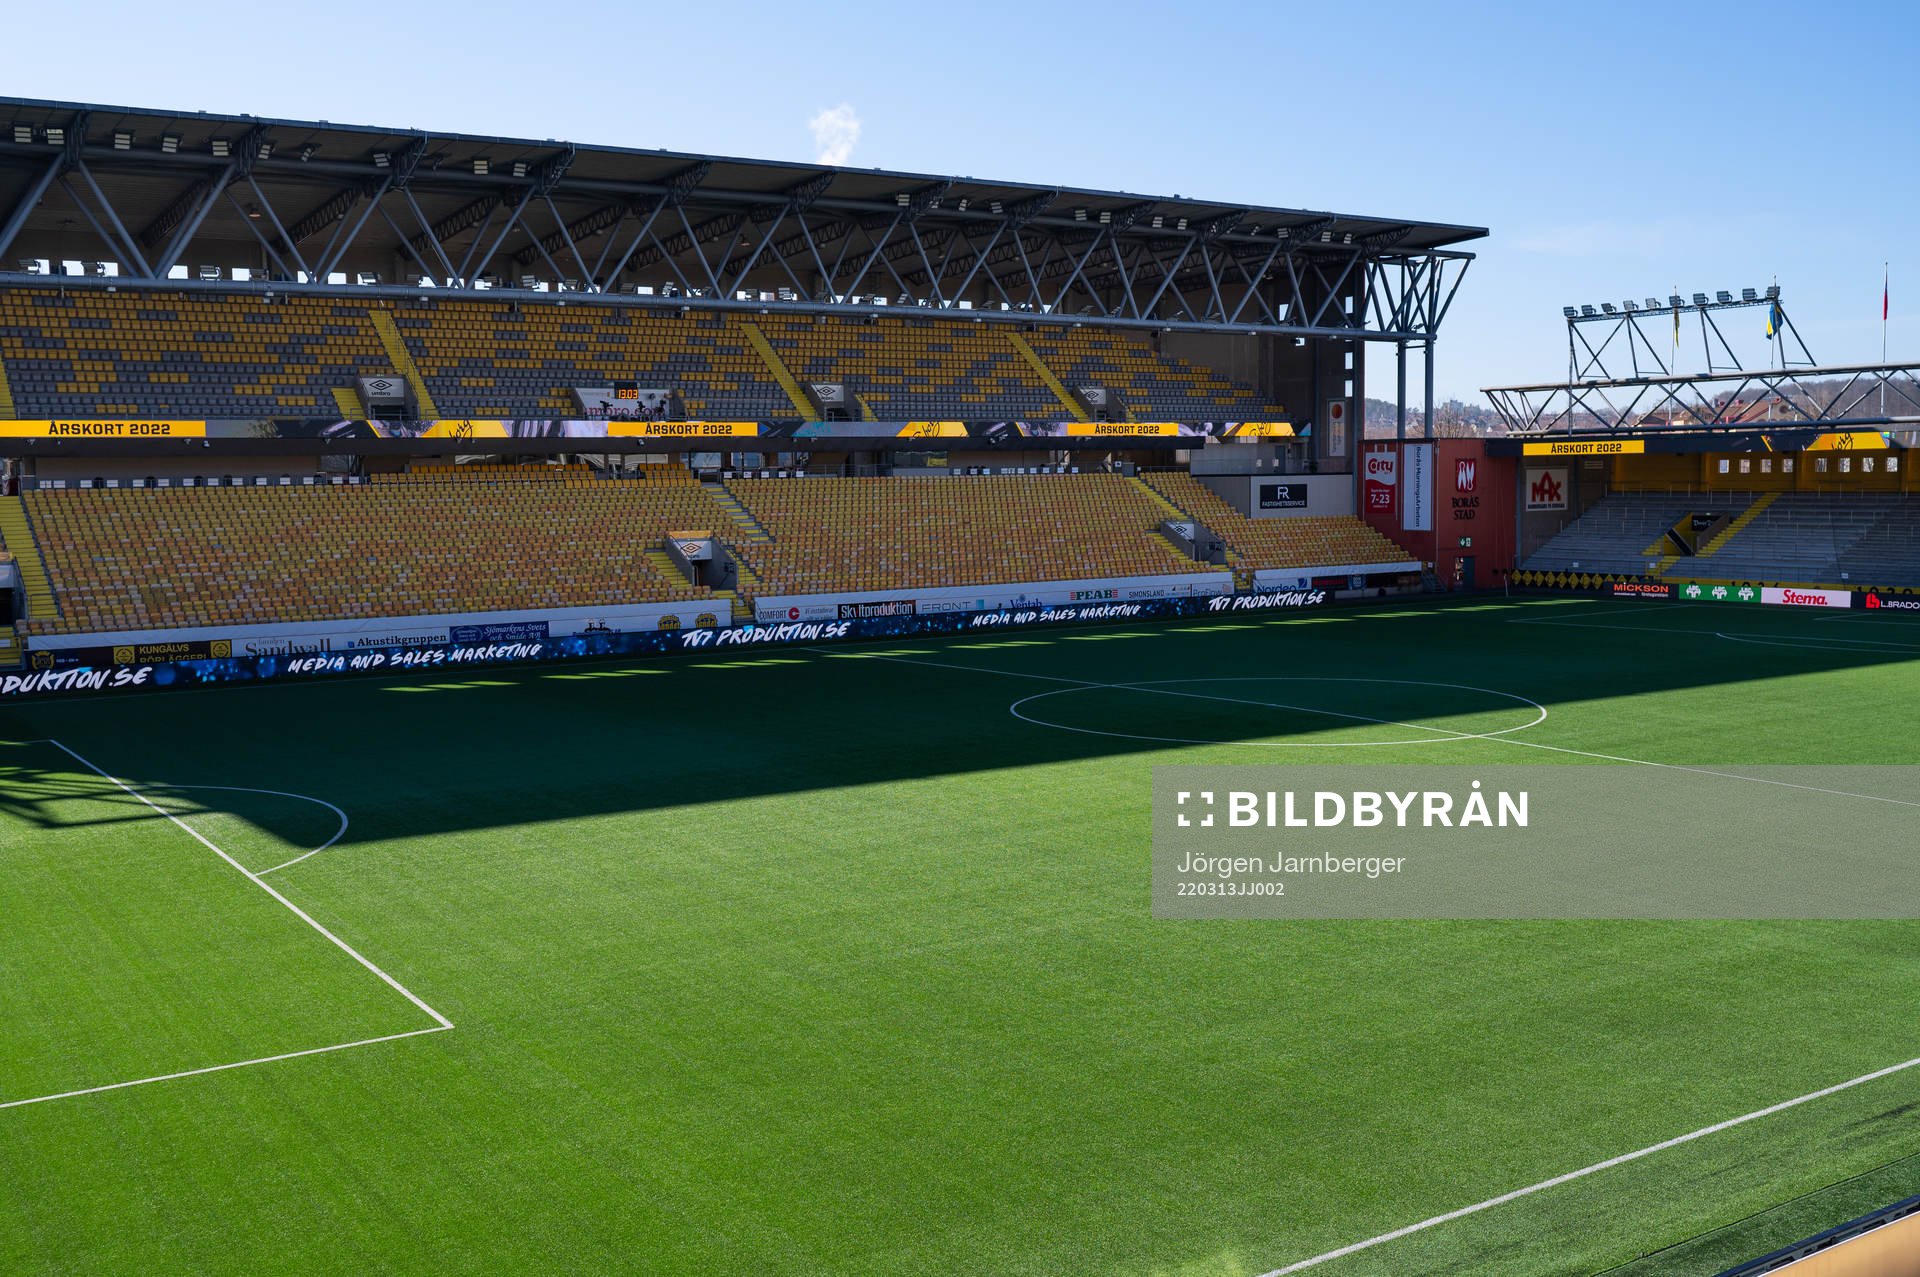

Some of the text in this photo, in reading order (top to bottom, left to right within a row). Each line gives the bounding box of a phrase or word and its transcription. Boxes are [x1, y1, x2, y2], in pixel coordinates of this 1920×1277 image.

[48, 419, 171, 435] ÅRSKORT 2022
[645, 422, 732, 434] ÅRSKORT 2022
[1094, 423, 1160, 434] ÅRSKORT 2022
[1551, 443, 1622, 454] ÅRSKORT 2022
[1368, 458, 1393, 474] City
[1532, 472, 1562, 502] MAX
[1370, 494, 1390, 504] 7-23
[1452, 495, 1480, 508] BORÅS
[1454, 509, 1476, 520] STAD
[1076, 590, 1113, 600] PEAB
[1232, 590, 1326, 611] PRODUKTION.SE
[922, 602, 971, 612] FRONT
[972, 603, 1142, 627] MEDIA AND SALES MARKETING
[357, 634, 446, 647] Akustikgruppen
[716, 622, 851, 646] PRODUKTION.SE
[140, 643, 190, 654] KUNGÄLVS
[288, 643, 542, 674] MEDIA AND SALES MARKETING
[0, 666, 152, 694] DUKTION.SE
